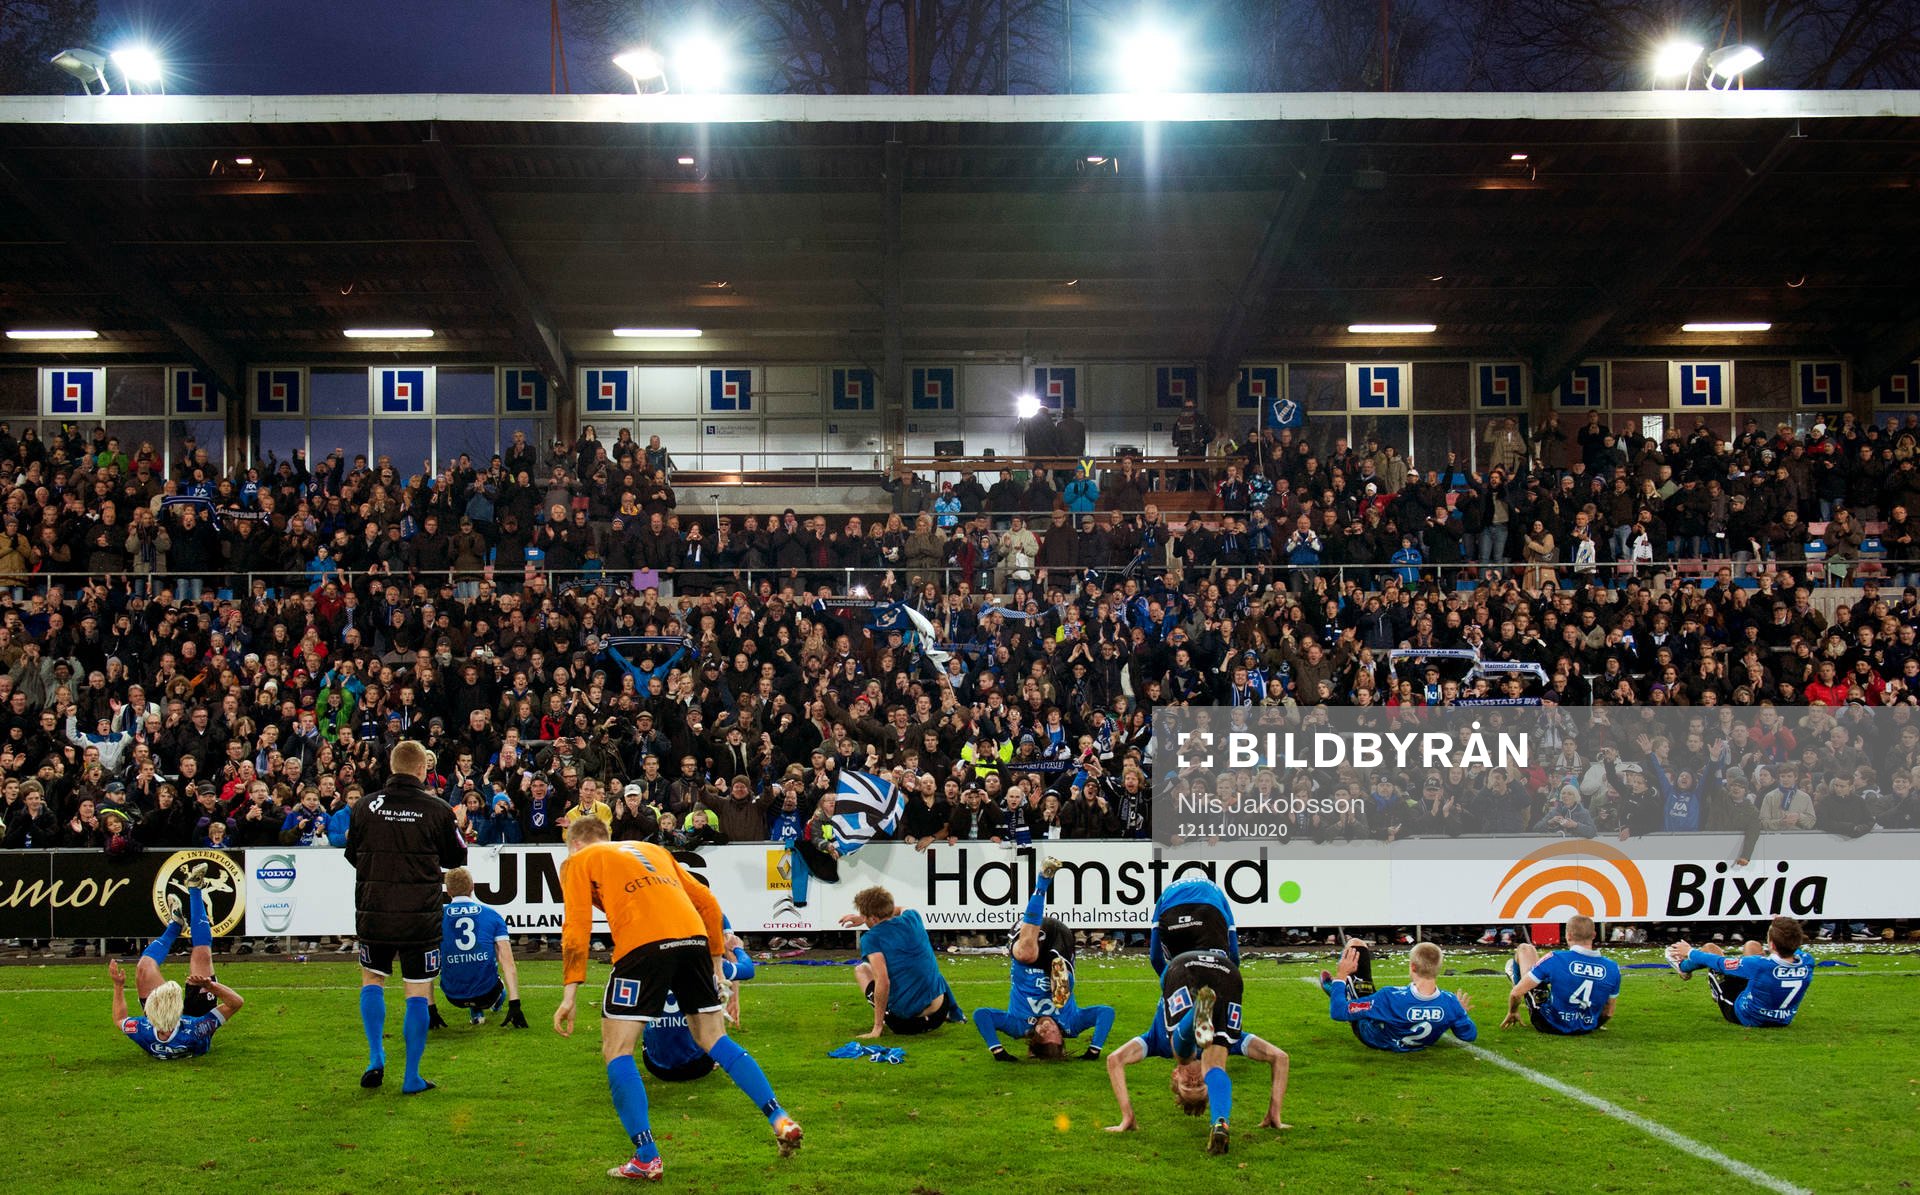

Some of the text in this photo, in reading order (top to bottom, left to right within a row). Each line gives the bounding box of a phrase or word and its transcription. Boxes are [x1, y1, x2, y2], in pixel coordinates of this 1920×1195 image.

[1080, 459, 1094, 477] Y
[1459, 698, 1539, 706] HALMSTADS BK
[187, 851, 239, 877] INTERFLORA
[0, 877, 131, 908] mor
[1666, 861, 1828, 917] Bixia
[157, 890, 172, 920] FLOWE
[450, 906, 479, 915] EAB
[213, 917, 233, 934] WIDE
[504, 914, 563, 928] ALLAN
[455, 917, 476, 951] 3
[447, 951, 488, 965] GETINGE
[1573, 962, 1604, 978] EAB
[1776, 966, 1808, 978] EAB
[1569, 979, 1594, 1010] 4
[1780, 980, 1803, 1009] 7
[649, 1016, 689, 1028] GETING
[1411, 1008, 1442, 1021] EAB
[1401, 1021, 1433, 1047] 2
